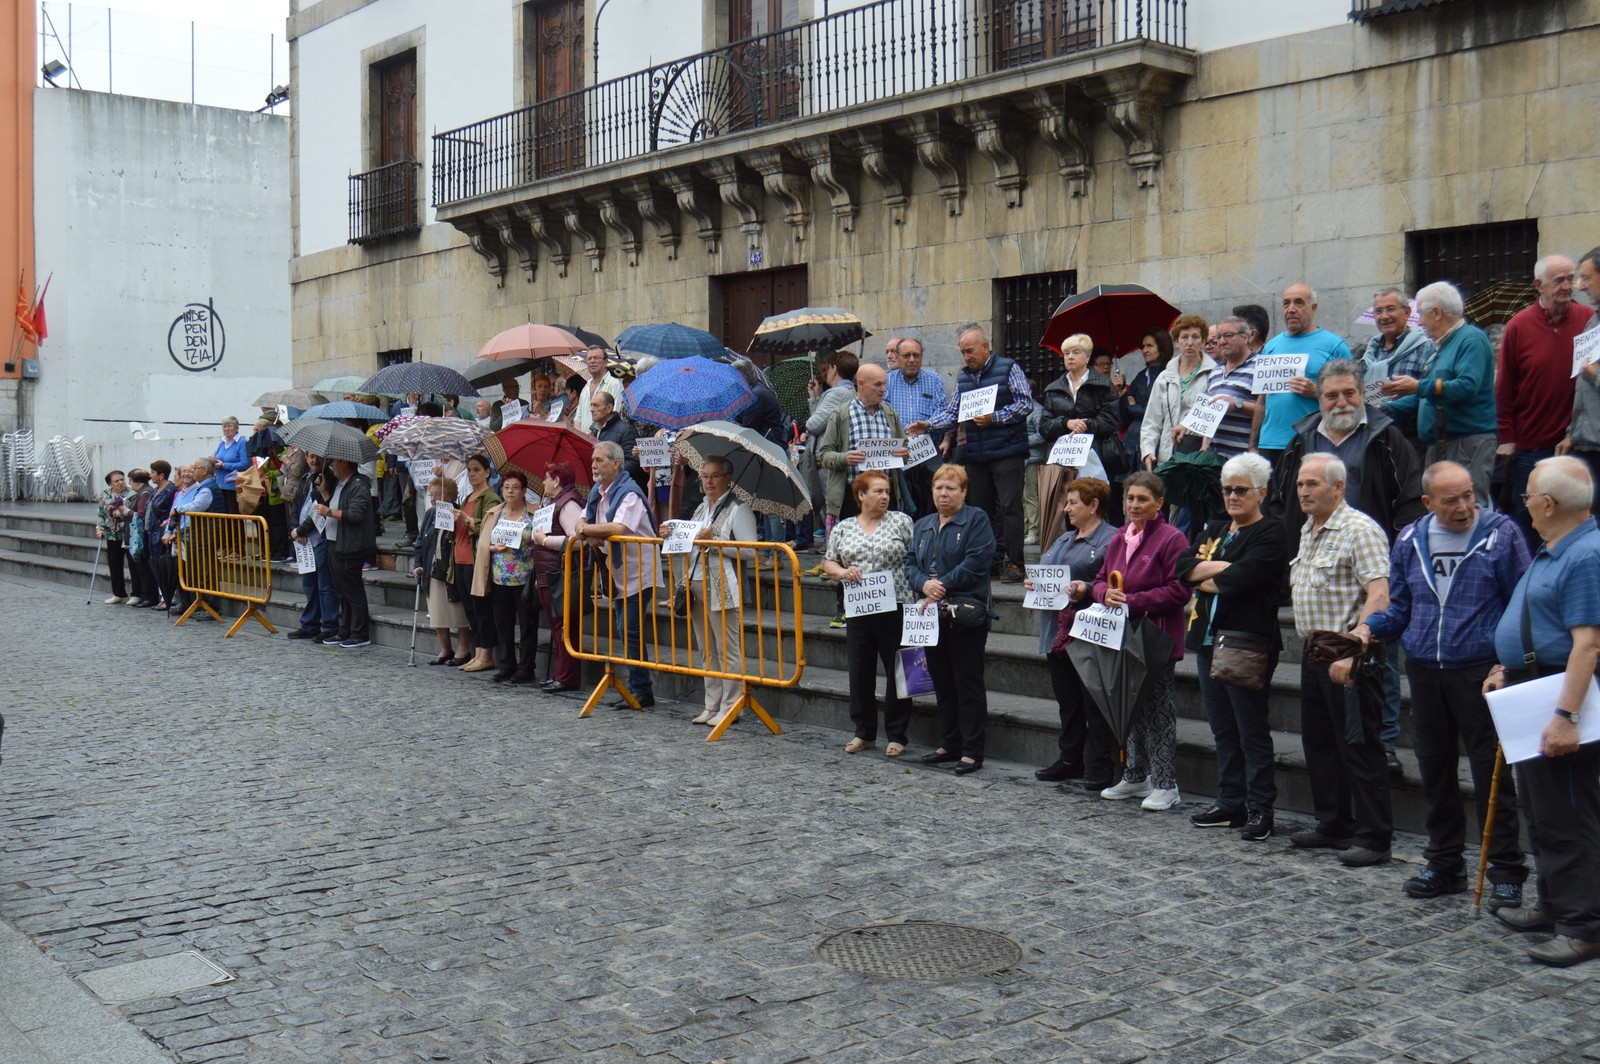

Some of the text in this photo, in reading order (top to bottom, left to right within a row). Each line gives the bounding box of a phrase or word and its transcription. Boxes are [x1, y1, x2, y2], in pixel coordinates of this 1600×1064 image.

[183, 309, 208, 323] INDE
[185, 323, 207, 334] PEN
[186, 335, 208, 347] DEN
[1575, 328, 1600, 349] PENTS
[1256, 356, 1302, 367] PENTSIO
[1257, 368, 1297, 379] DUINEN
[1261, 382, 1290, 392] ALDE
[961, 388, 994, 403] PENTSIO
[961, 398, 990, 411] DUINEN
[965, 408, 984, 419] ALDE
[1189, 421, 1209, 434] ALDE
[638, 439, 664, 448] PENTSIO
[859, 440, 899, 448] PENTSIO
[640, 448, 664, 459] DUINEN
[1052, 447, 1083, 455] DUINEN
[645, 459, 662, 467] ALDE
[866, 460, 891, 469] ALDE
[668, 542, 682, 551] ALDE
[1027, 568, 1065, 578] PENTSIO
[848, 588, 886, 603] DUINEN
[1032, 597, 1054, 608] ALDE
[855, 602, 882, 615] ALDE
[905, 621, 935, 630] DUINEN
[1078, 612, 1117, 631] DUINEN
[908, 634, 930, 644] ALDE
[1080, 628, 1107, 645] ALDE
